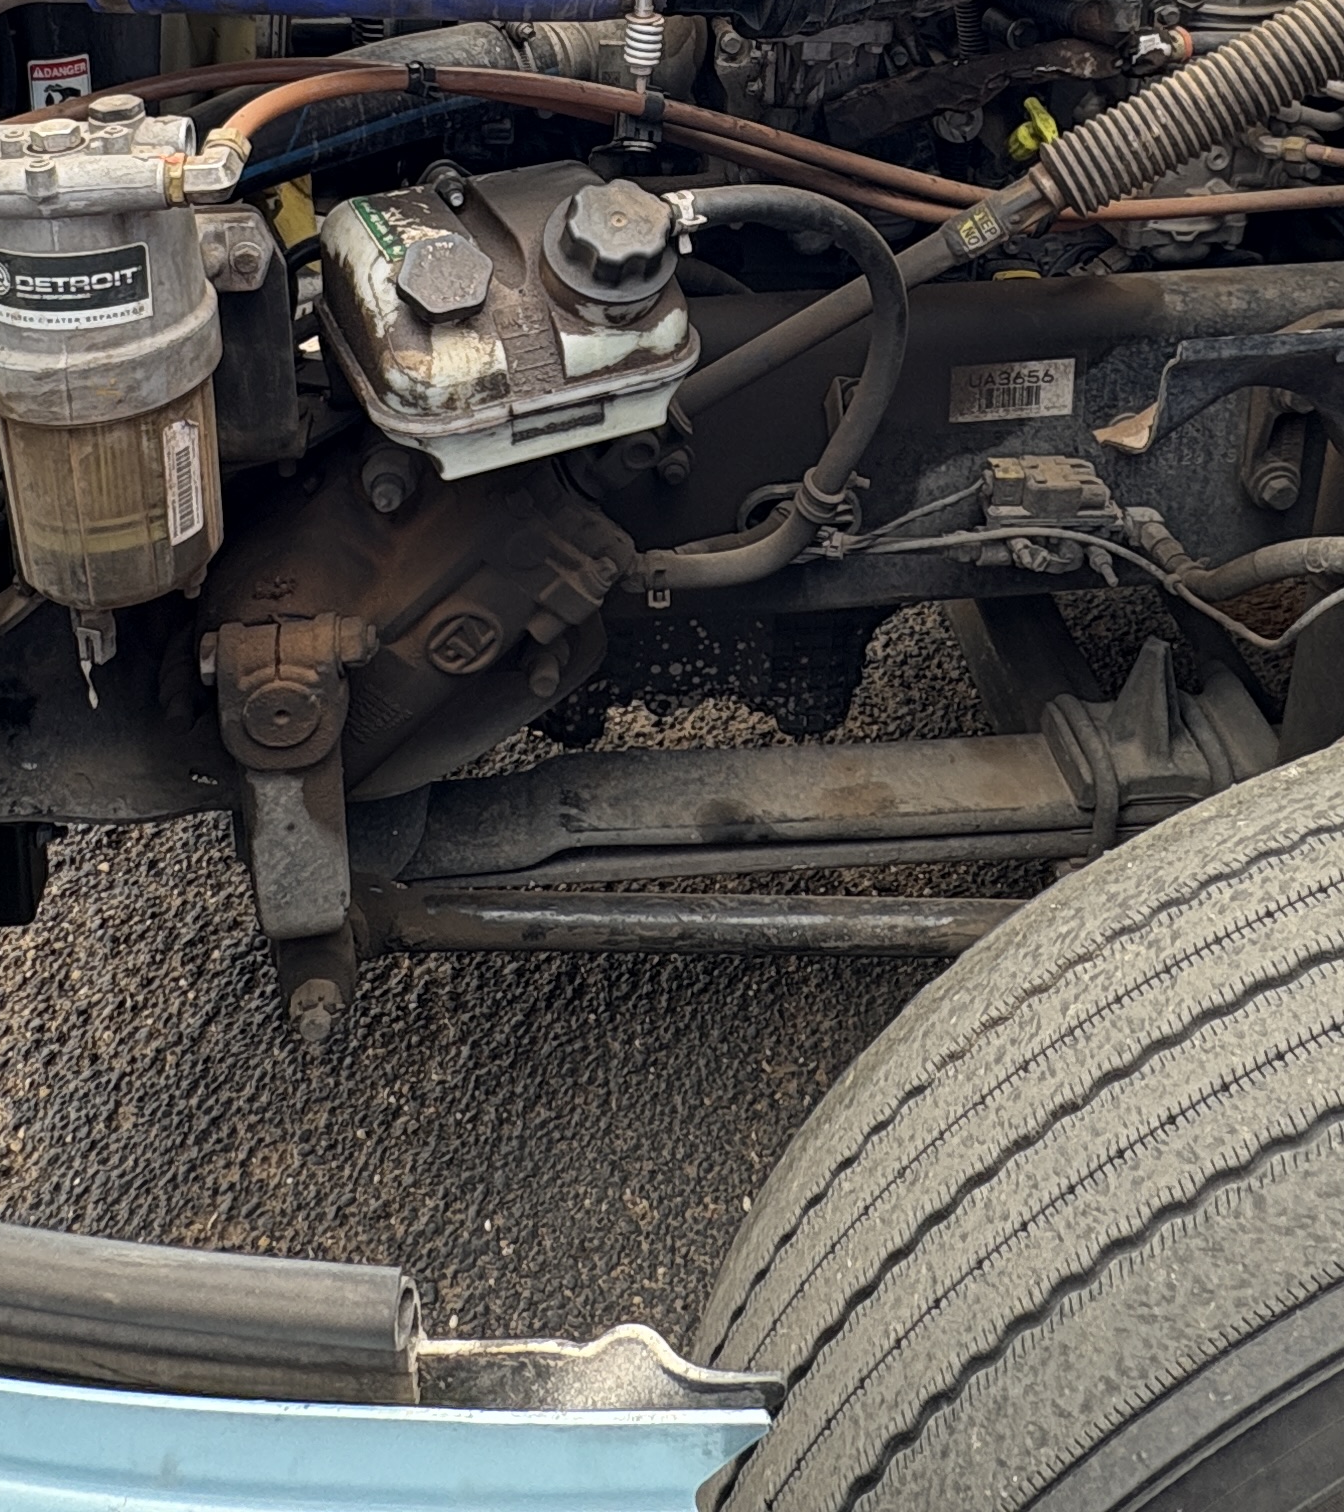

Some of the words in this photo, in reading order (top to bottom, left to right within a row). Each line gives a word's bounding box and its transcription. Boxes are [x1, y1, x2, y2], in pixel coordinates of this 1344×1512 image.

[43, 62, 87, 78] DANGER
[15, 266, 139, 293] DETROIT
[47, 316, 82, 325] WATER
[85, 304, 146, 324] SEPARATOR
[969, 369, 1055, 389] UA3656
